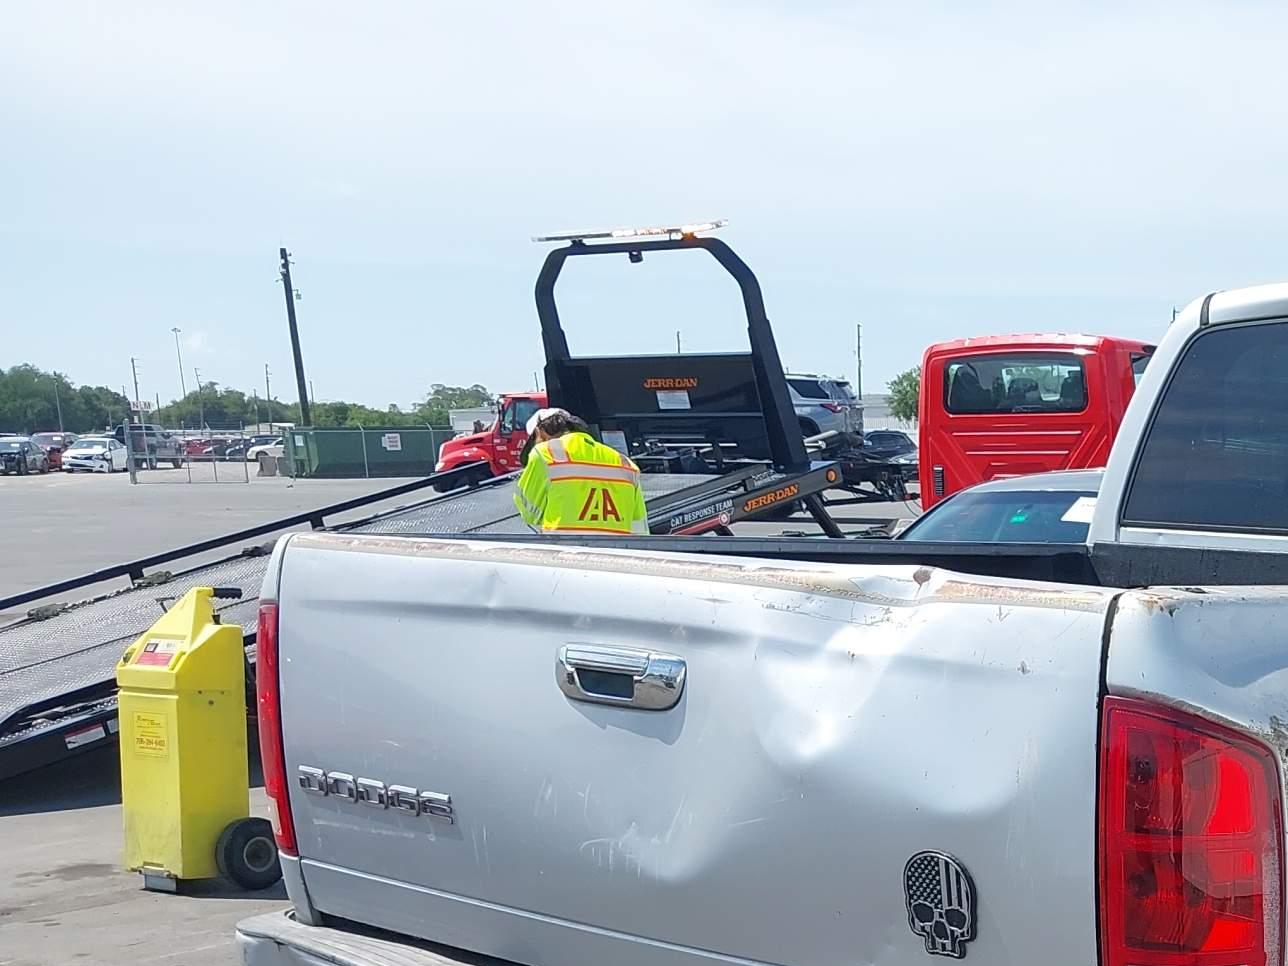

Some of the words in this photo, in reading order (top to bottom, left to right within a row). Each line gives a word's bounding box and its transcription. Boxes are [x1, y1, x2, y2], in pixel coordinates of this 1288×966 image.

[743, 483, 800, 512] JERR-DAN
[670, 515, 683, 528] CAT
[684, 504, 716, 523] RESPONSE
[716, 499, 733, 514] TEAM
[298, 764, 454, 825] DODGE
